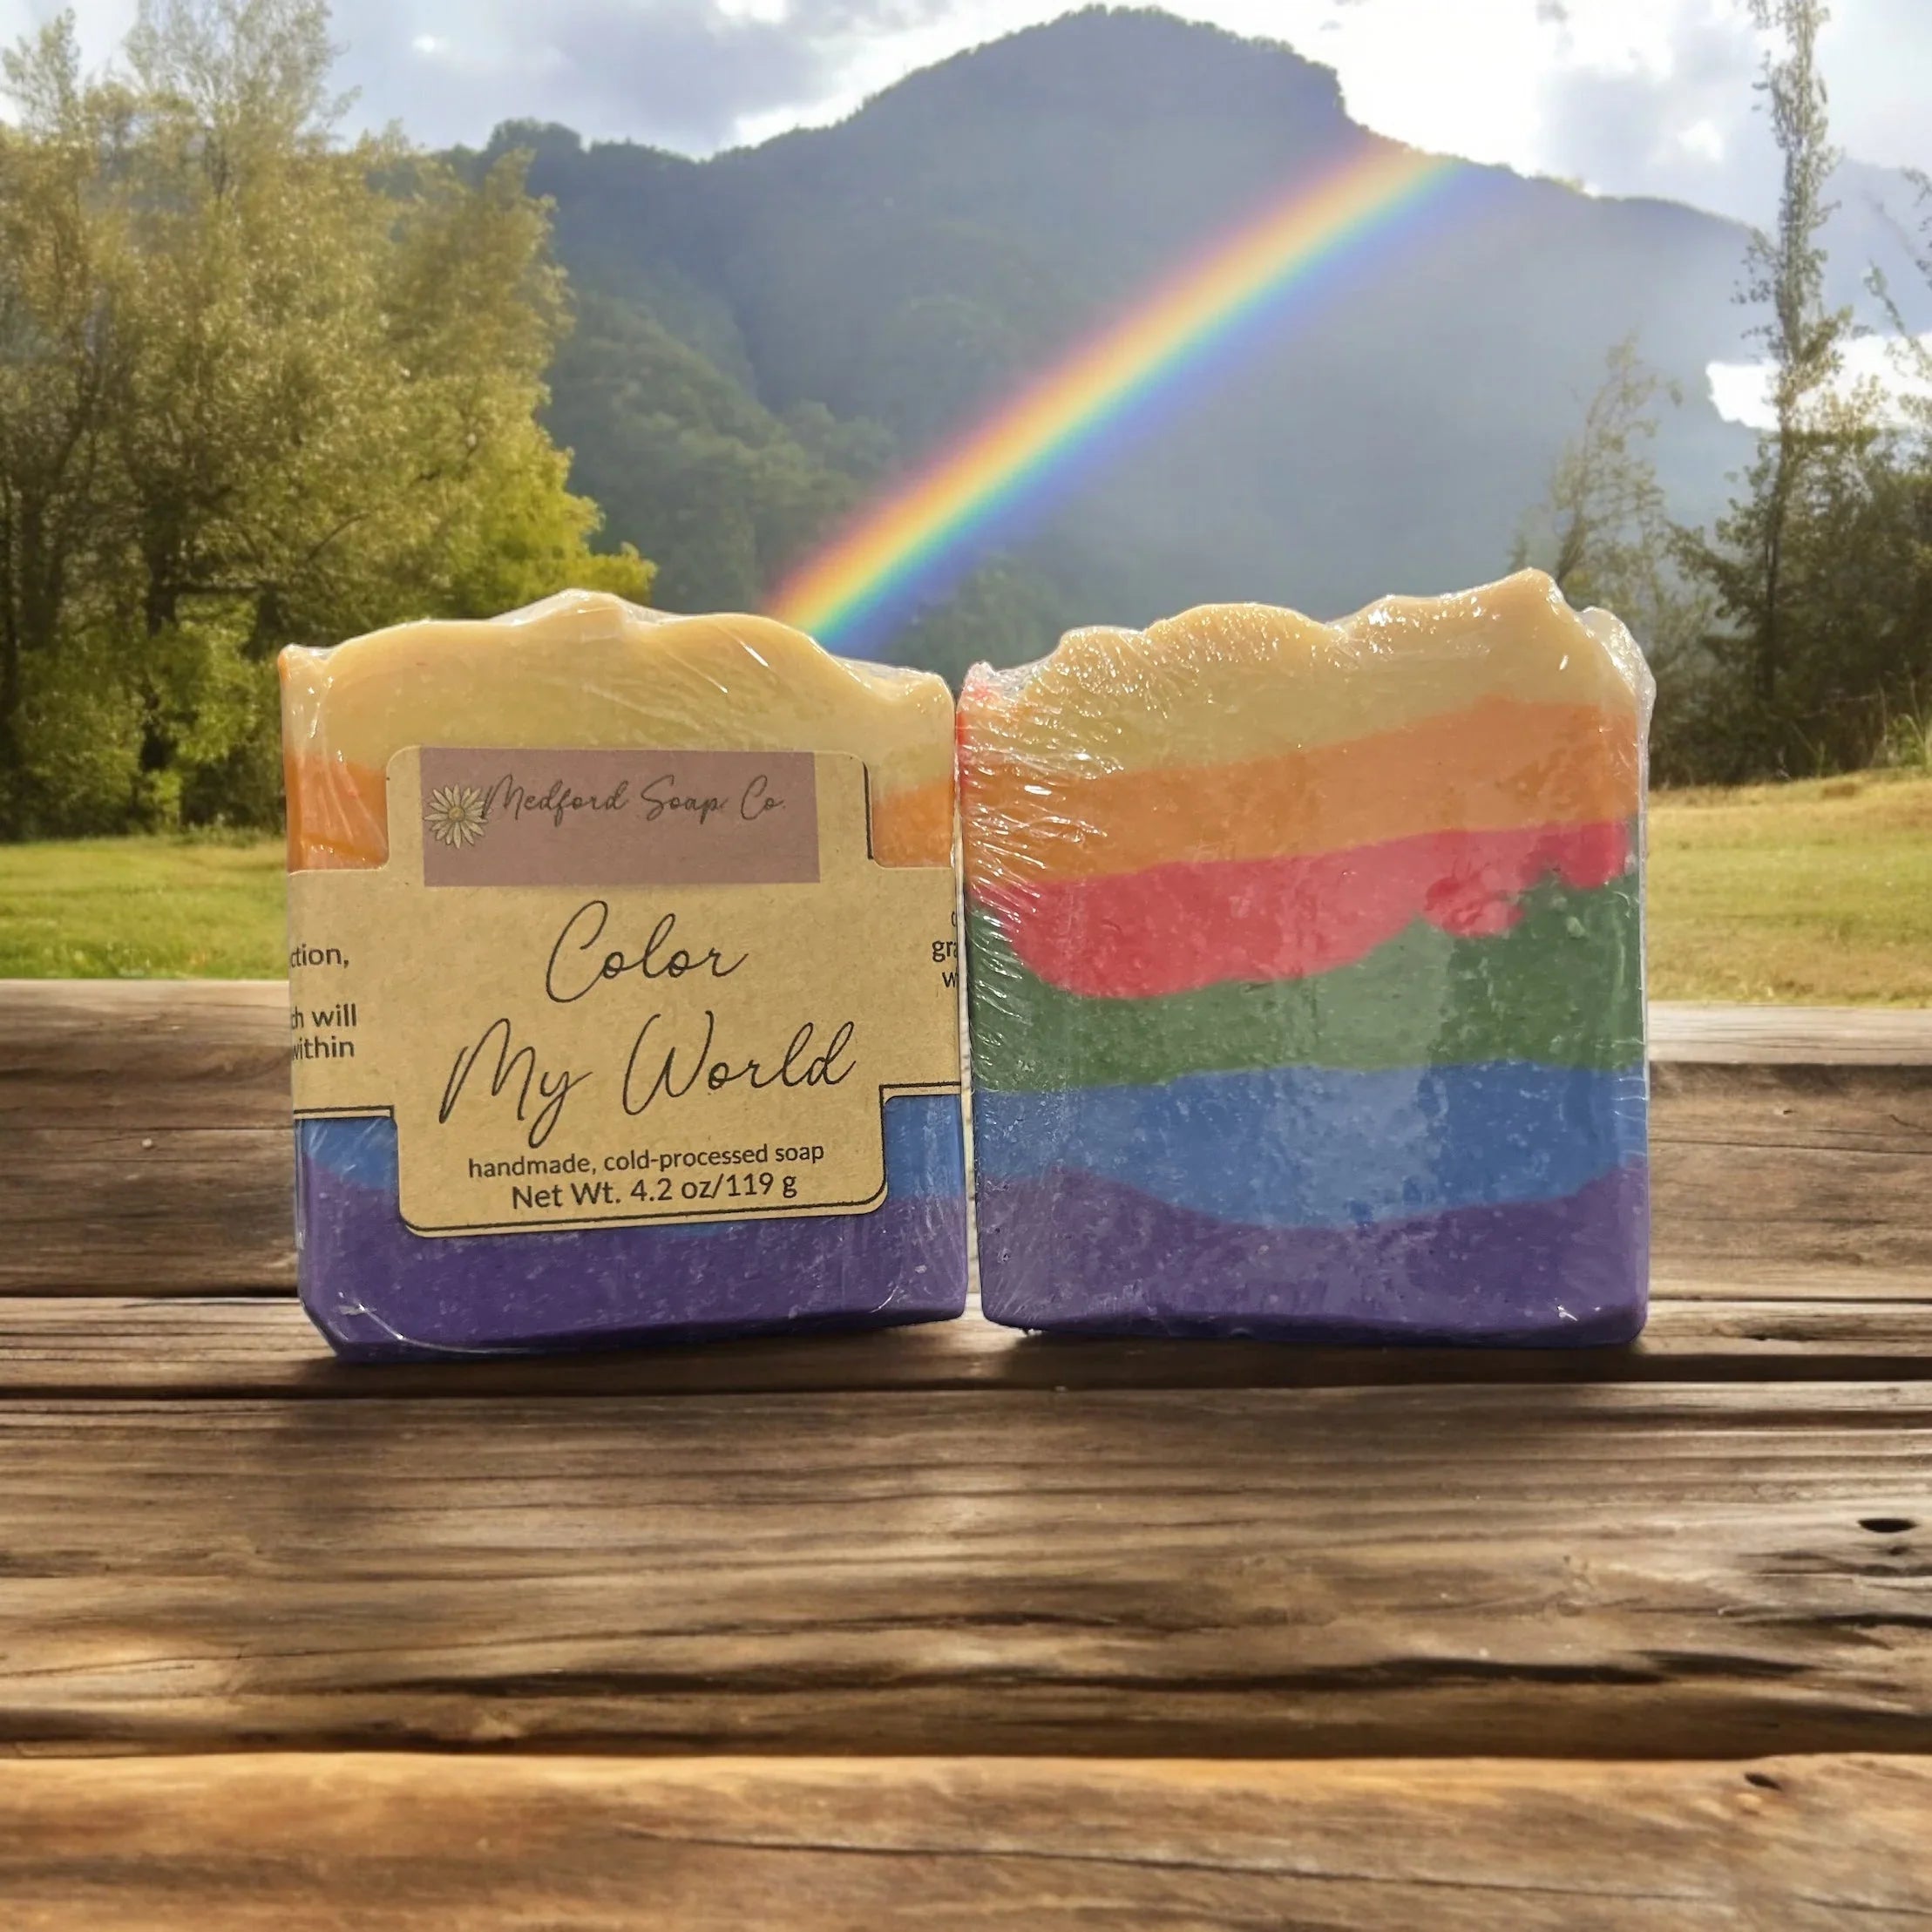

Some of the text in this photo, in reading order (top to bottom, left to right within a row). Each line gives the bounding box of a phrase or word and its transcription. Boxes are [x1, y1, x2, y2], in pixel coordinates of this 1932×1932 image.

[480, 774, 629, 827] Medford
[641, 774, 729, 825] Soap
[546, 900, 749, 1003] Color
[311, 1002, 357, 1027] will
[438, 1010, 857, 1149] My World
[468, 1143, 824, 1178] handmade, cold-processed soap
[512, 1172, 797, 1210] Net Wt. 4.2 oz/119 g
